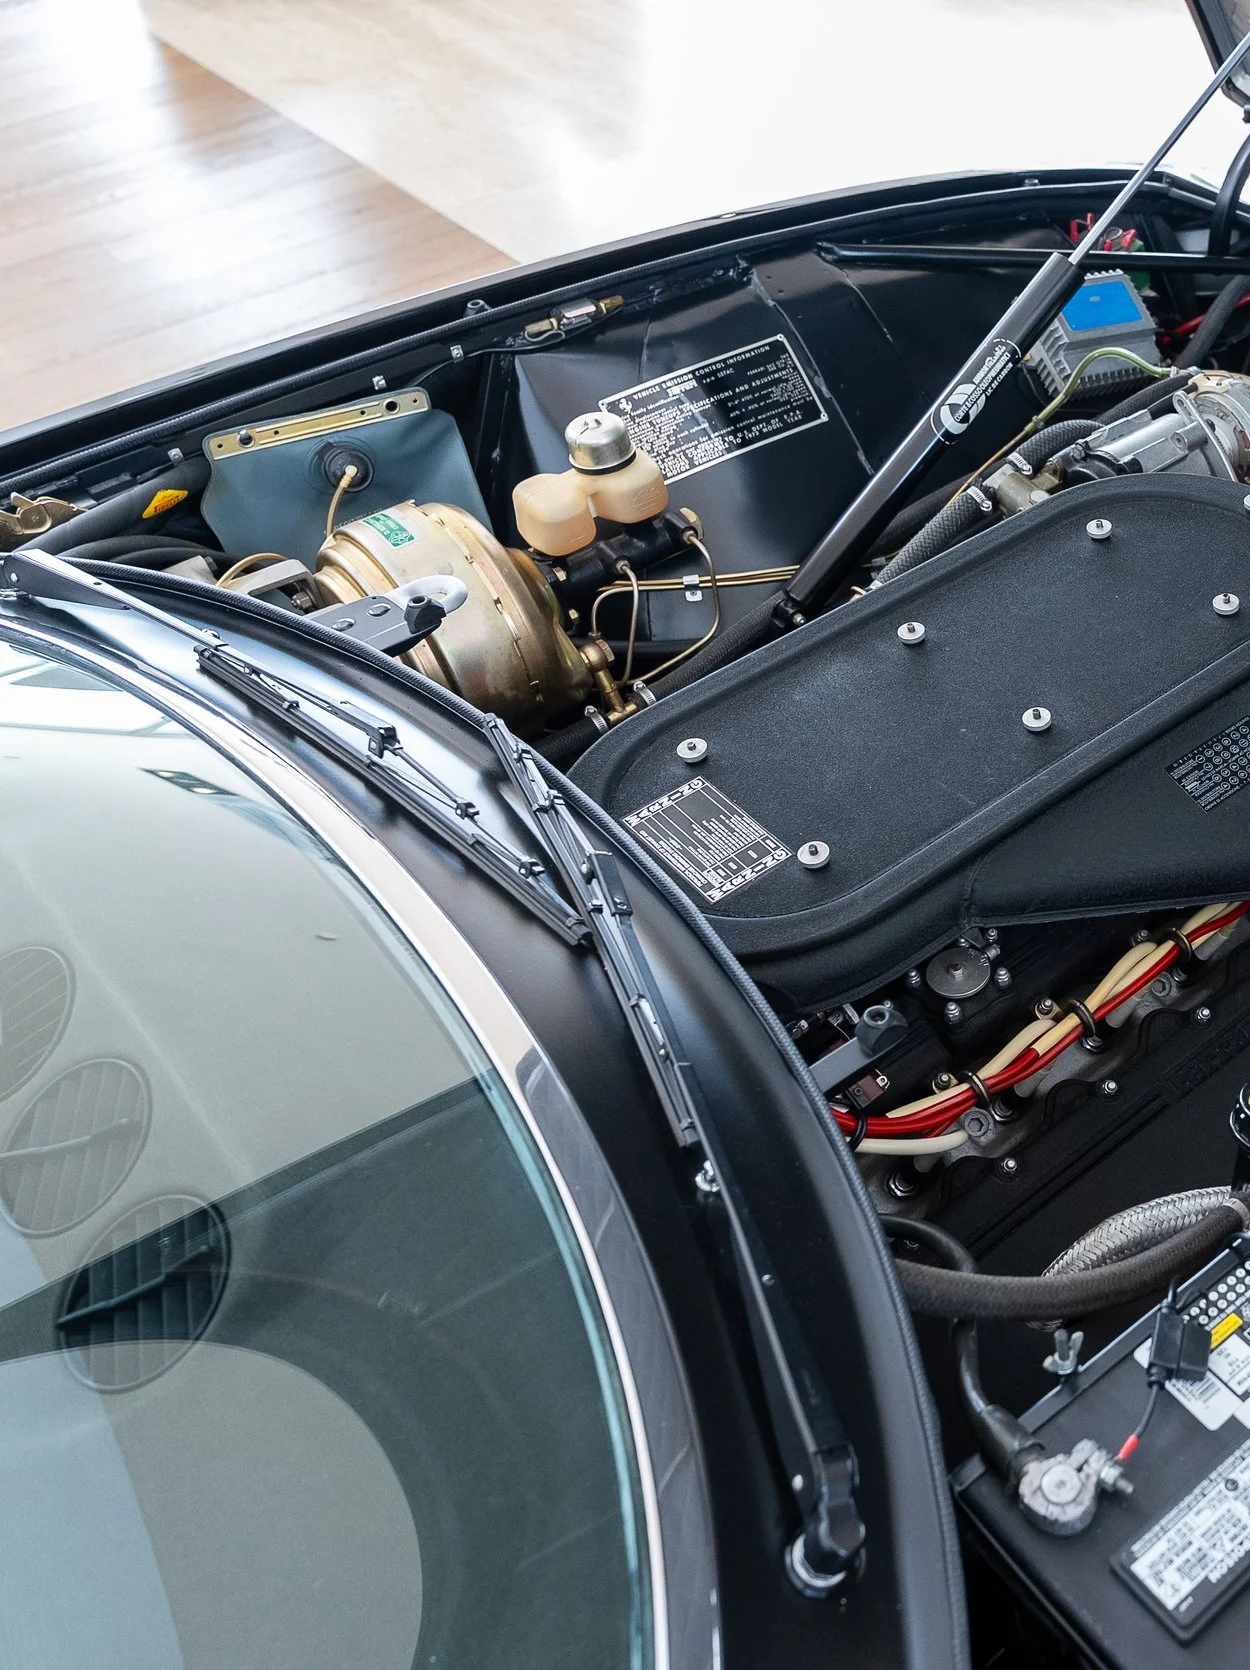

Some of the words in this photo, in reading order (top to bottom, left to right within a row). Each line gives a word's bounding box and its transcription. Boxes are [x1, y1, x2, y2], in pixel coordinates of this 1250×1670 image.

[632, 385, 661, 400] VEHICLE
[661, 373, 694, 388] EMISSION
[694, 361, 725, 377] CONTROL
[725, 344, 771, 365] INFORMATION
[681, 389, 733, 413] SPECIFICATIONS
[733, 383, 749, 393] AND
[750, 366, 794, 387] ADJUSTMENTS
[667, 439, 699, 456] operations
[698, 434, 709, 442] for
[709, 424, 735, 438] emission
[735, 416, 756, 428] control
[756, 403, 791, 420] maintenance
[791, 398, 805, 406] must
[953, 403, 969, 422] CORTE
[966, 386, 983, 405] COSSO
[692, 442, 730, 461] APPLICABLE
[744, 430, 760, 439] 1973
[761, 421, 783, 433] MODEL
[786, 414, 803, 423] YEAR
[665, 464, 691, 477] MOTOR
[693, 450, 723, 466] VEHICLES
[625, 778, 703, 827] WARNING
[707, 848, 787, 901] WARNING
